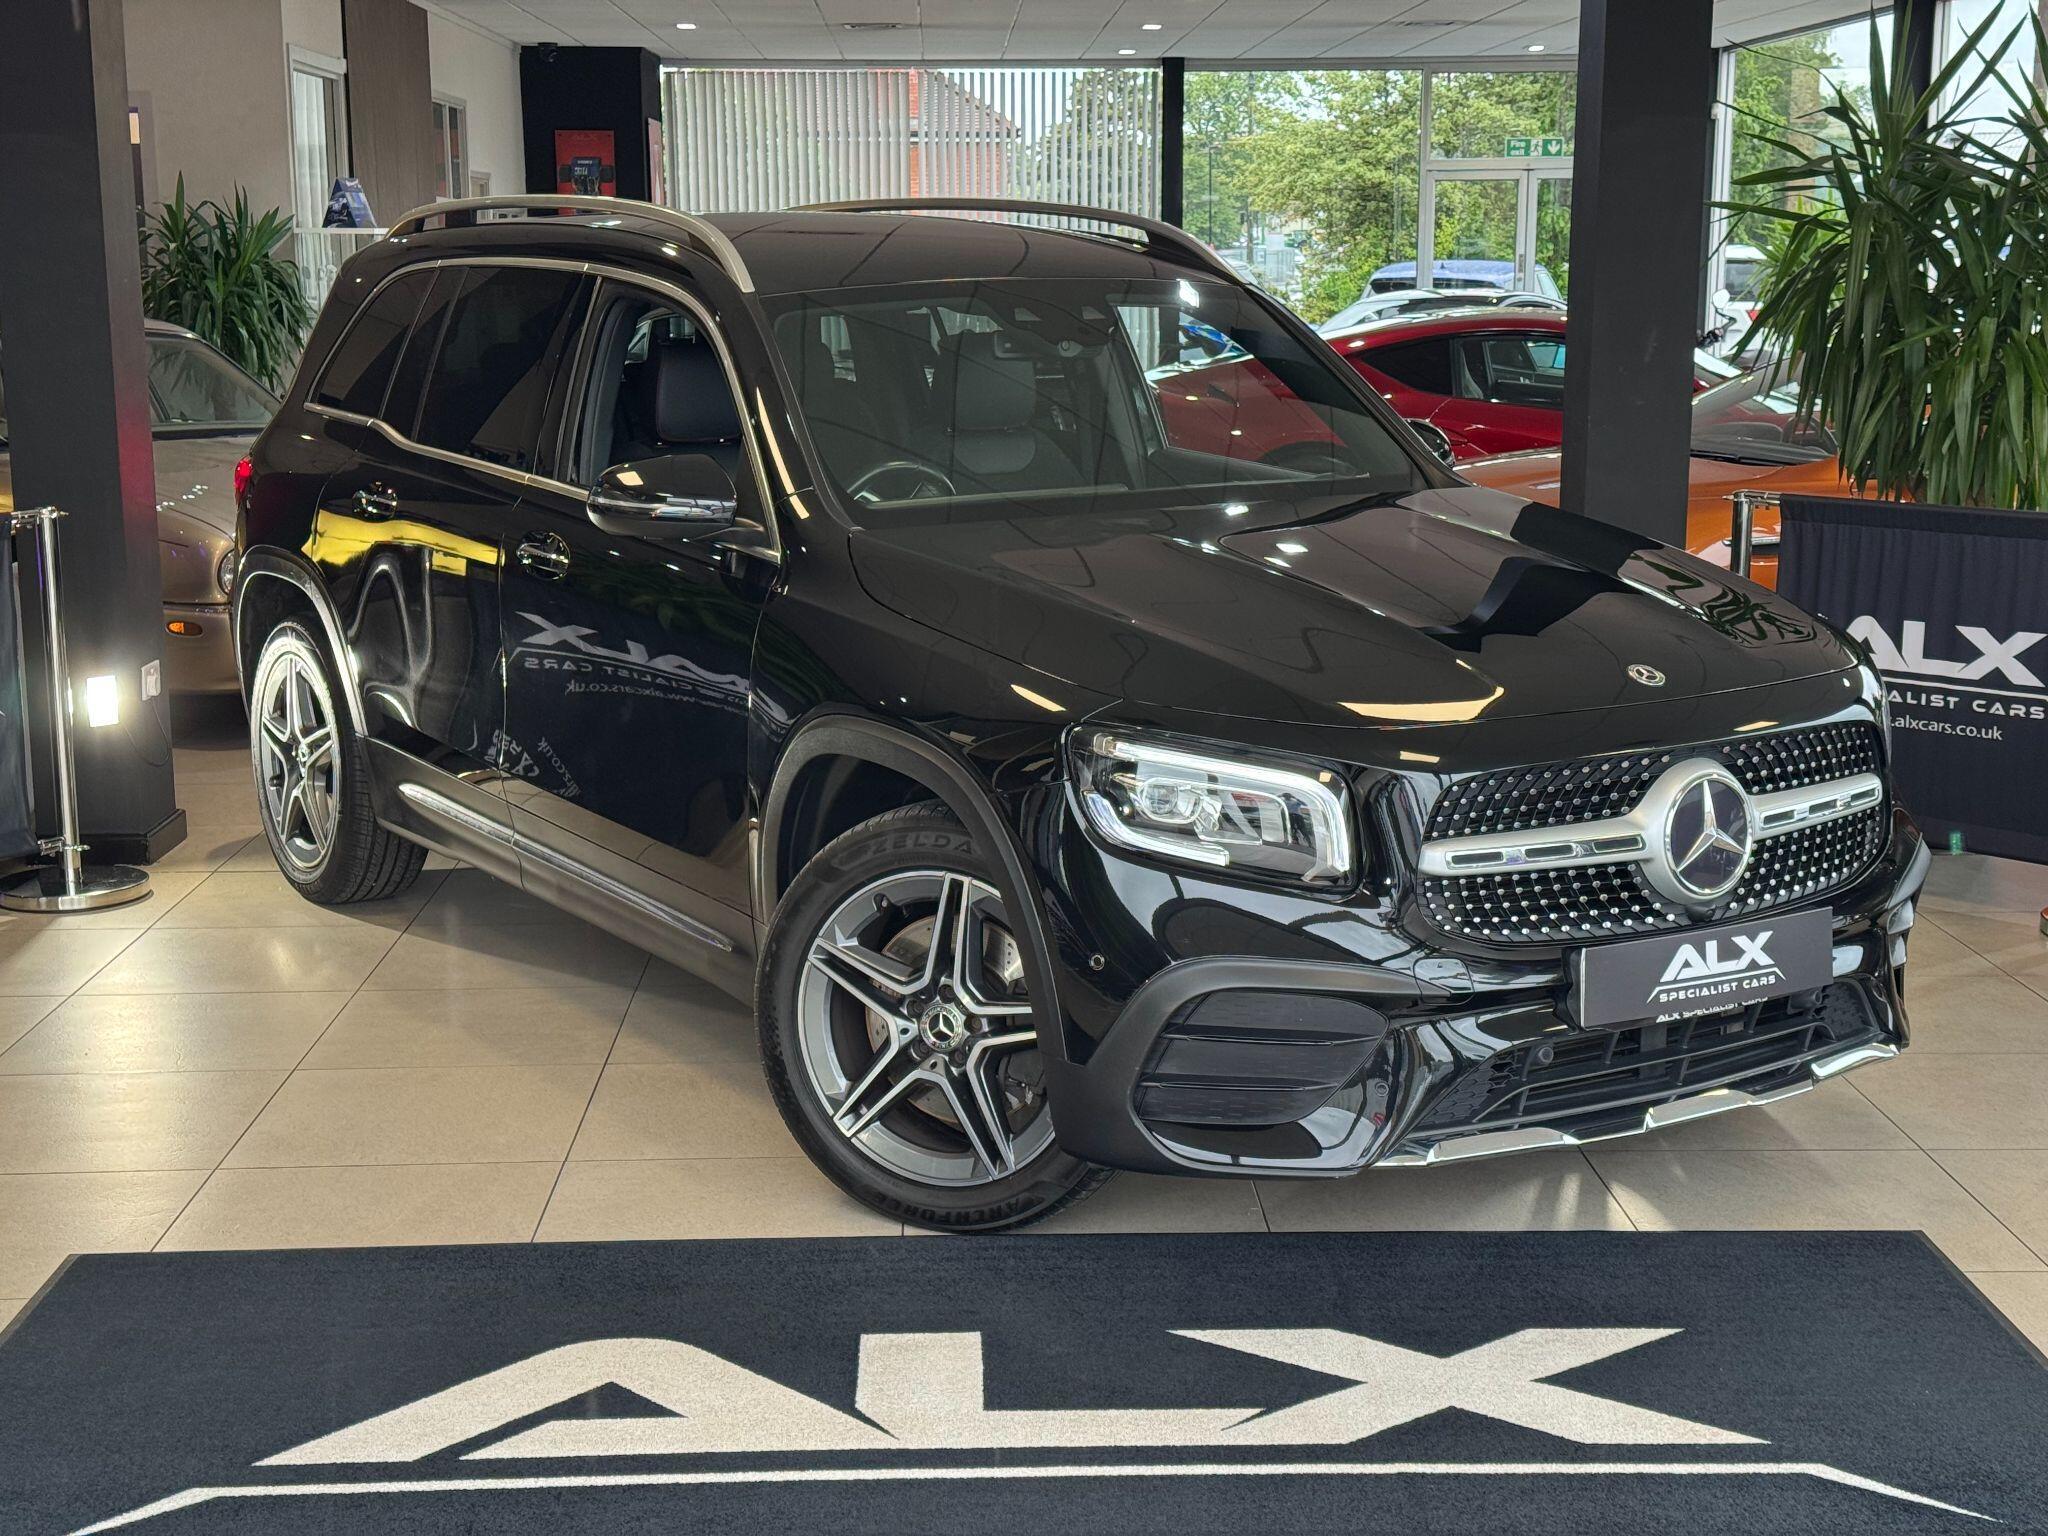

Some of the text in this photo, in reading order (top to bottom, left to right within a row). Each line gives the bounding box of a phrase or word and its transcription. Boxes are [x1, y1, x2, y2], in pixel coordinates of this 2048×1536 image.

[1510, 140, 1526, 148] Fire
[1846, 615, 2048, 688] ALX
[1888, 689, 2045, 720] ALIST CARS
[1890, 714, 2003, 740] .alxcars.co.uk
[1660, 931, 1775, 983] ALX
[1659, 974, 1776, 1002] SPECIALIST CARS
[1656, 1012, 1680, 1023] ALX
[252, 1327, 1772, 1467] ALX
